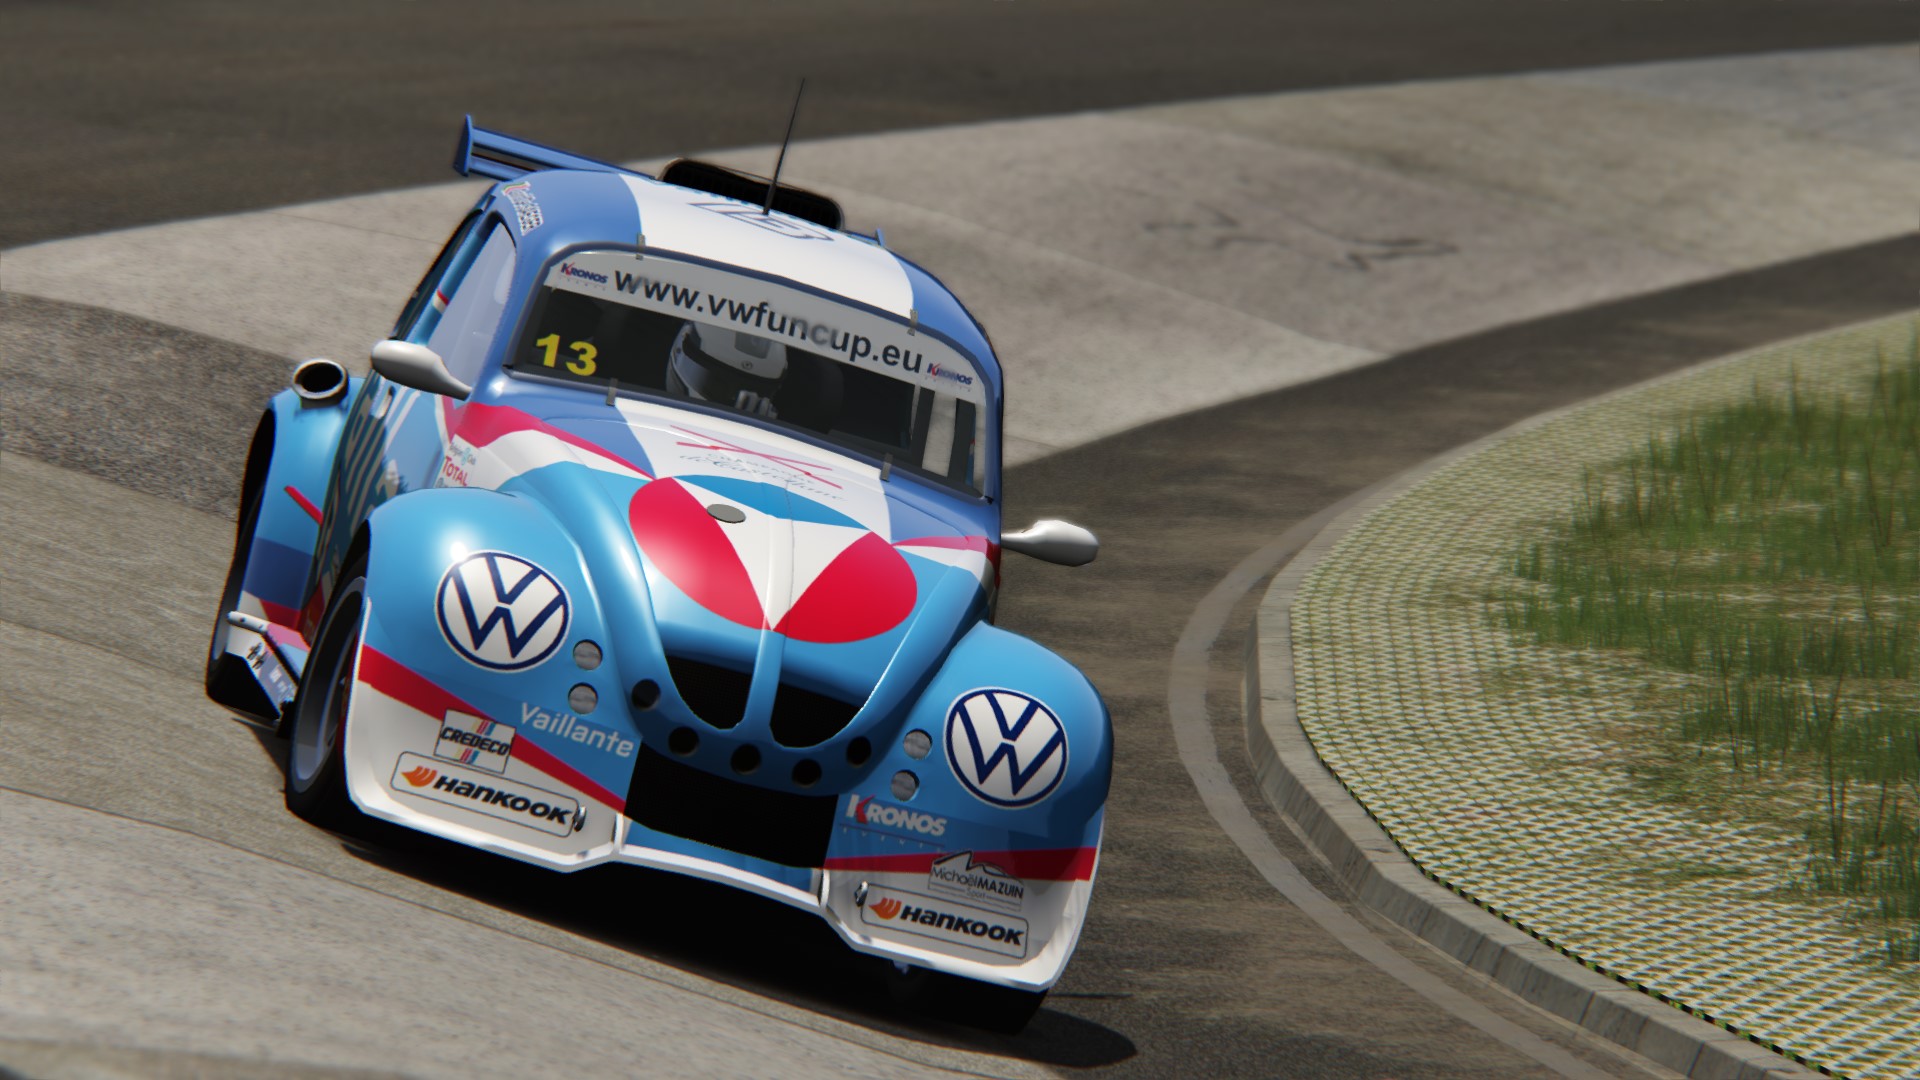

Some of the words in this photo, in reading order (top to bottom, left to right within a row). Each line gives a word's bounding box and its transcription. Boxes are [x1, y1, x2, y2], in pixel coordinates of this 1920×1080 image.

[561, 262, 608, 284] KRONOS
[615, 270, 923, 374] www.vwfuncup.eu
[536, 333, 598, 376] 13
[443, 455, 468, 487] TOTAL
[439, 727, 512, 757] CREDECO
[521, 702, 635, 758] Vaillante
[846, 794, 948, 836] KRONOS
